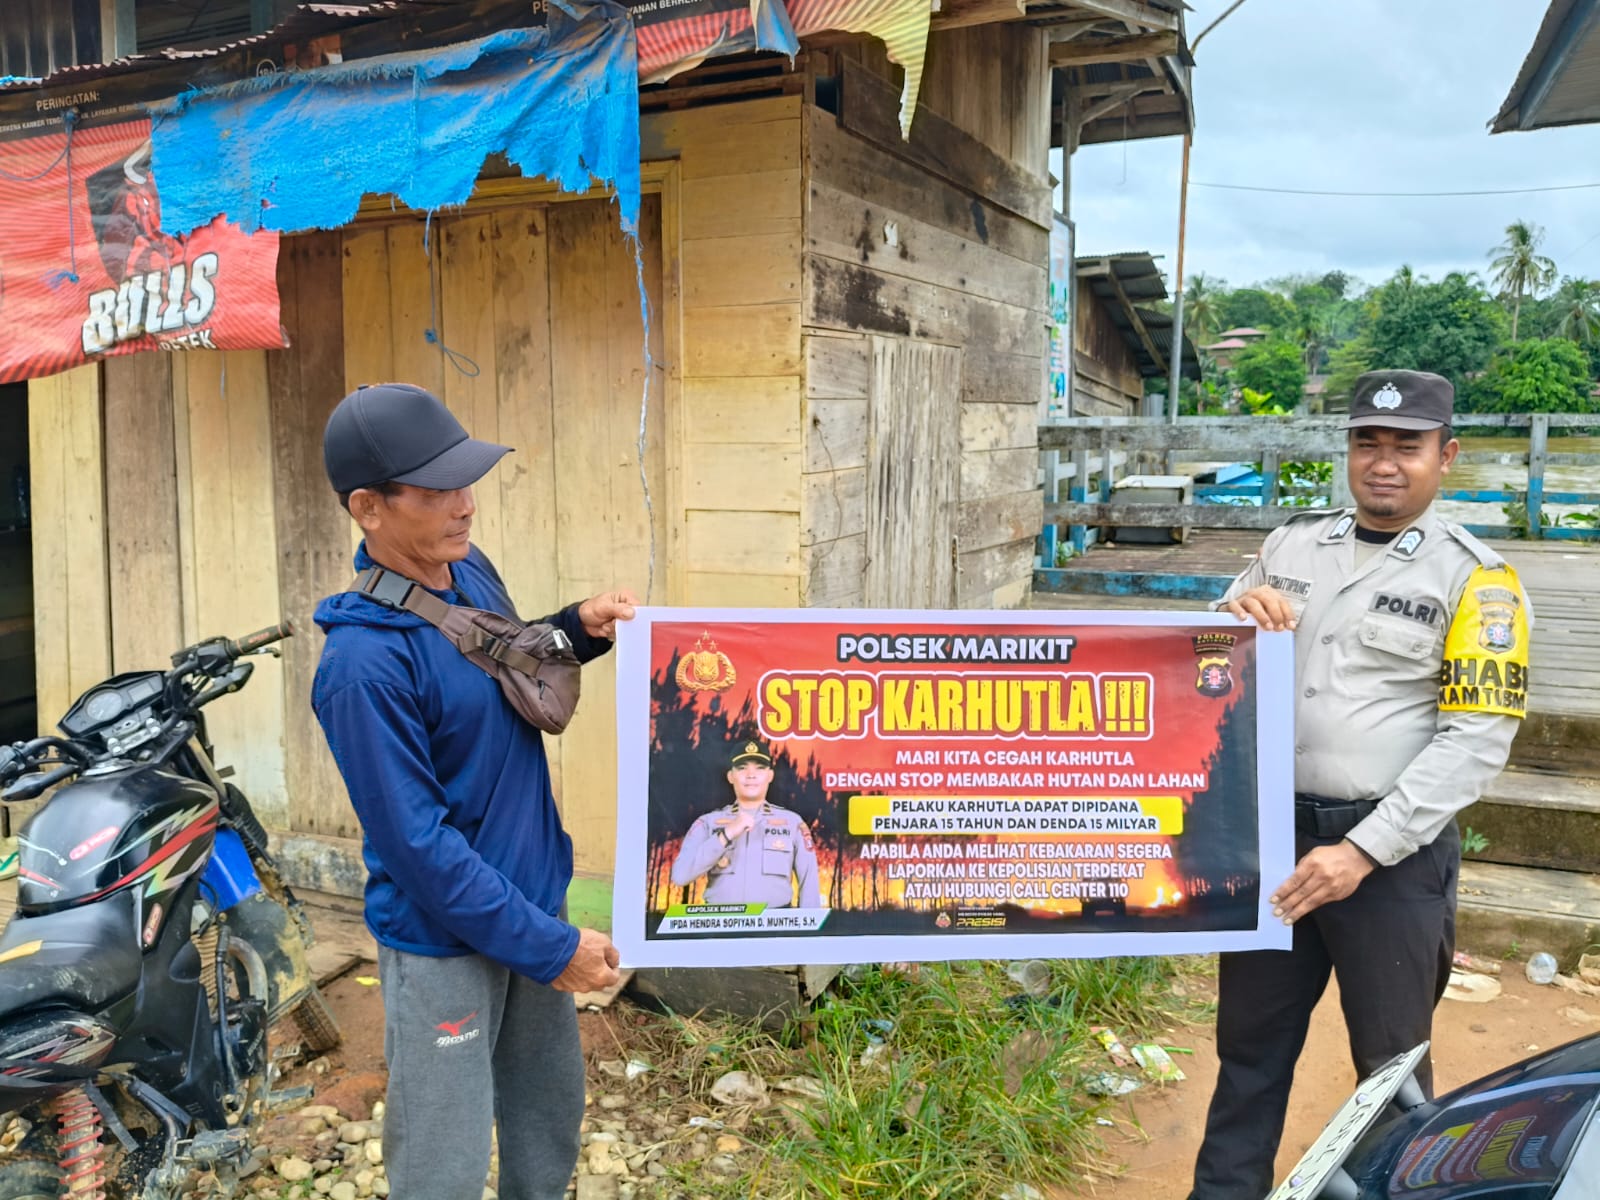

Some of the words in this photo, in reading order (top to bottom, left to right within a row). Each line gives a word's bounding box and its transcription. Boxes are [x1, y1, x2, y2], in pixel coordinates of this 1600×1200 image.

[82, 251, 218, 355] BULLS
[1375, 594, 1438, 624] POLRI
[840, 637, 946, 660] POLSEK
[951, 637, 1073, 661] MARIKIT
[765, 678, 873, 732] STOP
[882, 679, 1096, 732] KARHUTLA
[895, 751, 940, 765] MARI
[944, 751, 981, 765] KITA
[983, 751, 1043, 766] CEGAH
[1046, 751, 1135, 766] KARHUTLA
[825, 773, 897, 787] DENGAN
[901, 773, 944, 788] STOP
[946, 773, 1045, 788] MEMBAKAR
[1047, 773, 1105, 788] HUTAN
[1108, 773, 1145, 788] DAN
[1148, 774, 1206, 788] LAHAN
[892, 801, 944, 812] PELAKU
[948, 801, 1021, 812] KARHUTLA
[1024, 801, 1068, 812] DAPAT
[1072, 801, 1138, 813] DIPIDANA
[875, 818, 938, 829] PENJARA
[942, 818, 953, 829] 15
[956, 818, 1003, 829] TAHUN
[1007, 818, 1036, 829] DAN
[1040, 818, 1087, 829] DENDA
[1091, 818, 1102, 829] 15
[1106, 818, 1156, 829] MILYAR
[860, 844, 922, 859] APABILA
[922, 844, 964, 859] ANDA
[966, 844, 1027, 859] MELIHAT
[1029, 844, 1115, 859] KEBAKARAN
[1117, 844, 1172, 859] SEGERA
[888, 863, 966, 879] LAPORKAN
[968, 863, 986, 878] KE
[988, 863, 1073, 878] KEPOLISIAN
[1074, 863, 1145, 879] TERDEKAT
[905, 883, 943, 898] ATAU
[945, 883, 1011, 898] HUBUNGI
[1013, 883, 1050, 898] CALL
[1051, 883, 1107, 898] CENTER
[1109, 883, 1129, 898] 110
[670, 919, 688, 929] IPDA
[690, 919, 720, 929] HENDRA
[723, 918, 756, 928] SOPIYAN
[956, 917, 1006, 927] PRESISI
